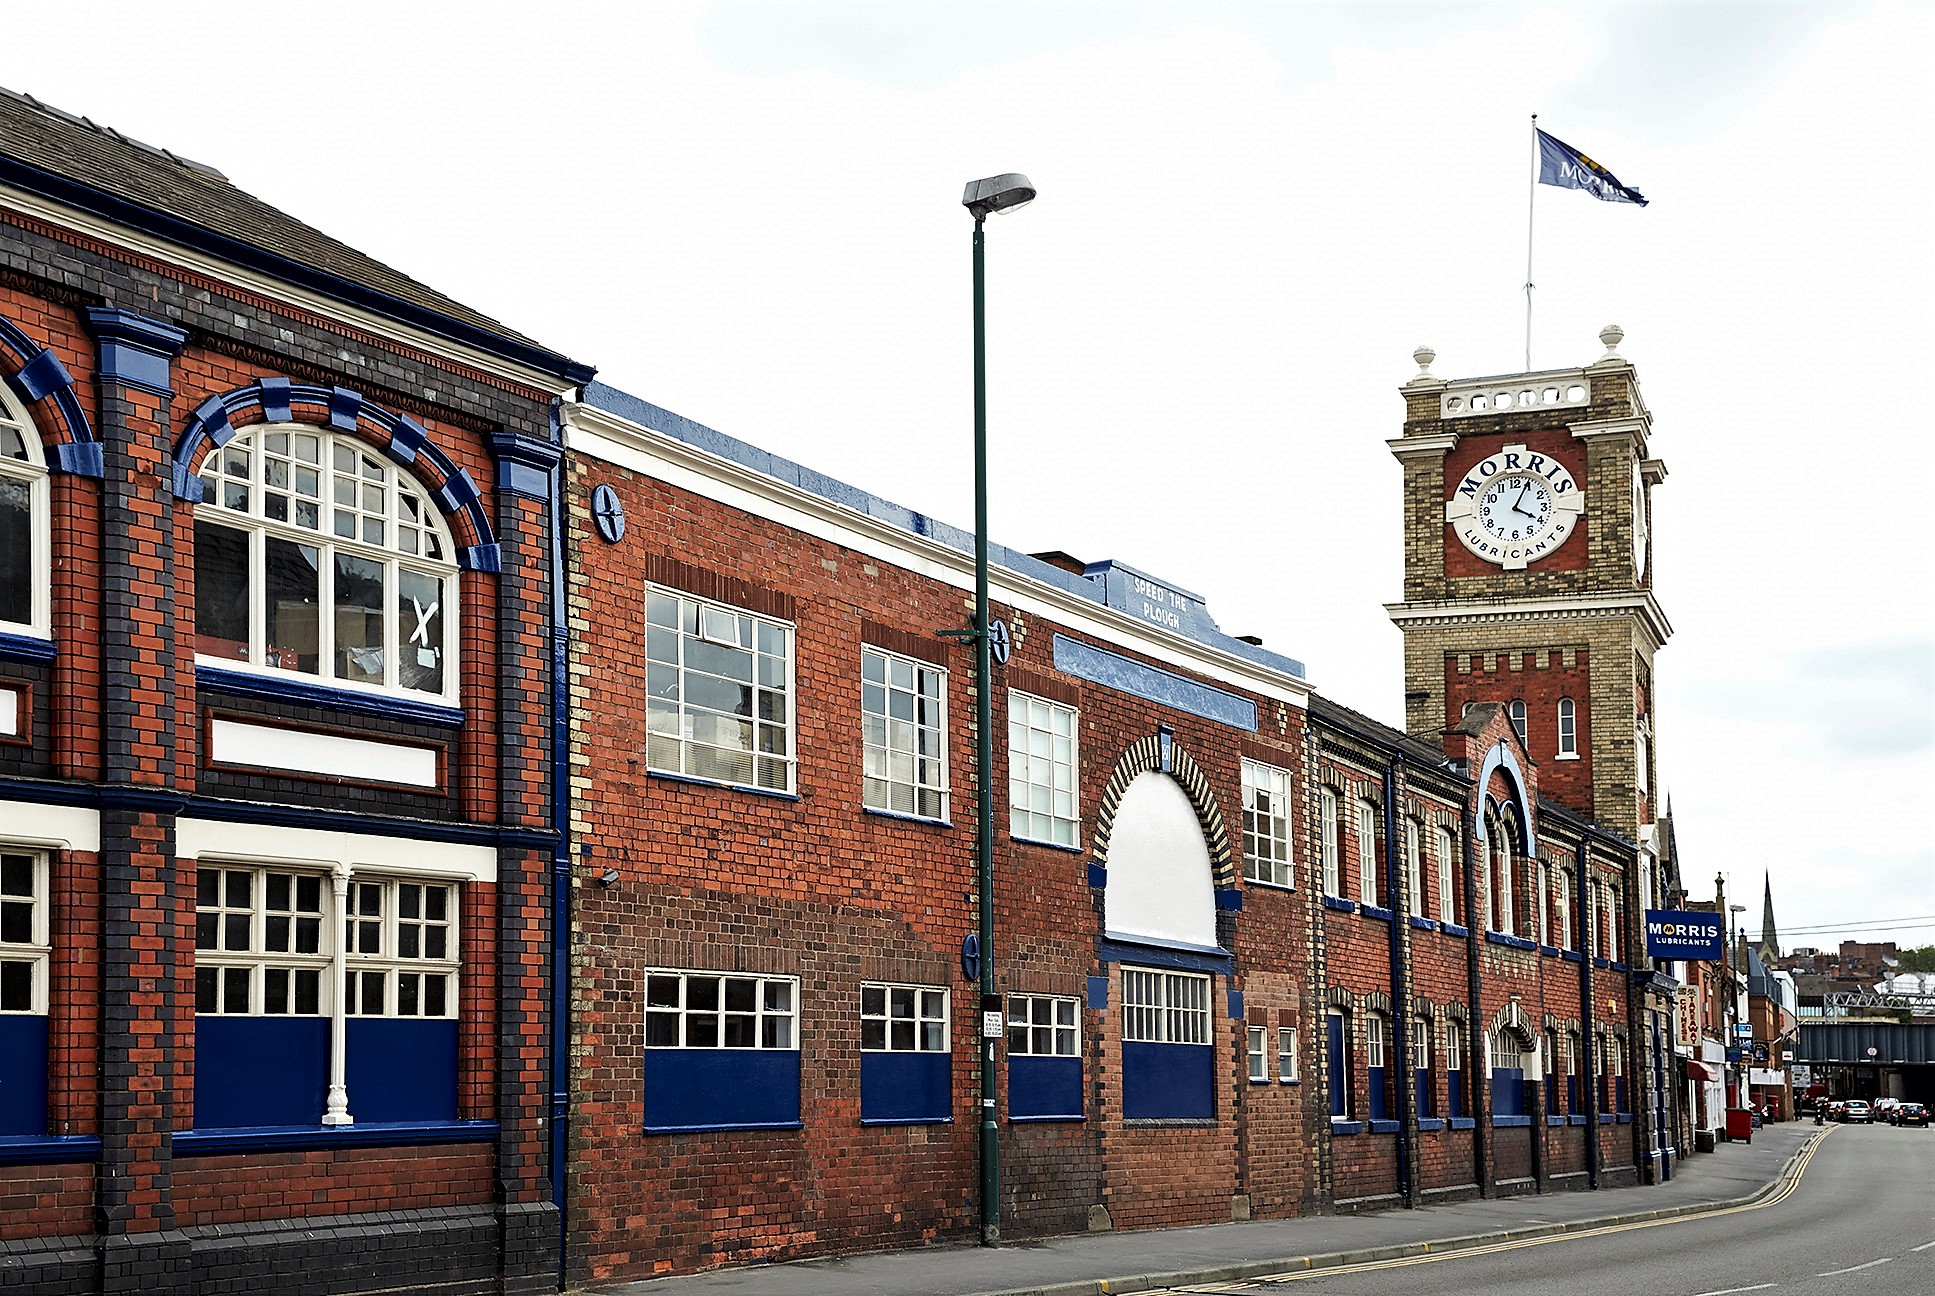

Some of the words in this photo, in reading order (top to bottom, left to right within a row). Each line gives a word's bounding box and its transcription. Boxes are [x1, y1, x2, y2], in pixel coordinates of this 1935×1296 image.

[1459, 453, 1572, 499] MORRIS
[1498, 484, 1505, 493] 11
[1510, 479, 1521, 489] 12
[1487, 494, 1498, 503] 10
[1536, 490, 1544, 500] 2
[1483, 506, 1491, 516] 9
[1540, 503, 1548, 512] 3
[1486, 519, 1494, 528] 8
[1536, 515, 1544, 524] 4
[1497, 527, 1505, 537] 7
[1511, 530, 1519, 539] 6
[1526, 525, 1534, 535] 5
[1464, 525, 1565, 559] LUBRICANTS
[1134, 577, 1164, 603] SPEED
[1169, 592, 1187, 612] THE
[1143, 601, 1180, 629] PLOUGH
[1648, 922, 1718, 937] MORRIS
[1656, 937, 1711, 946] LUBRICANTS
[1688, 995, 1698, 1044] TAKEAWAY
